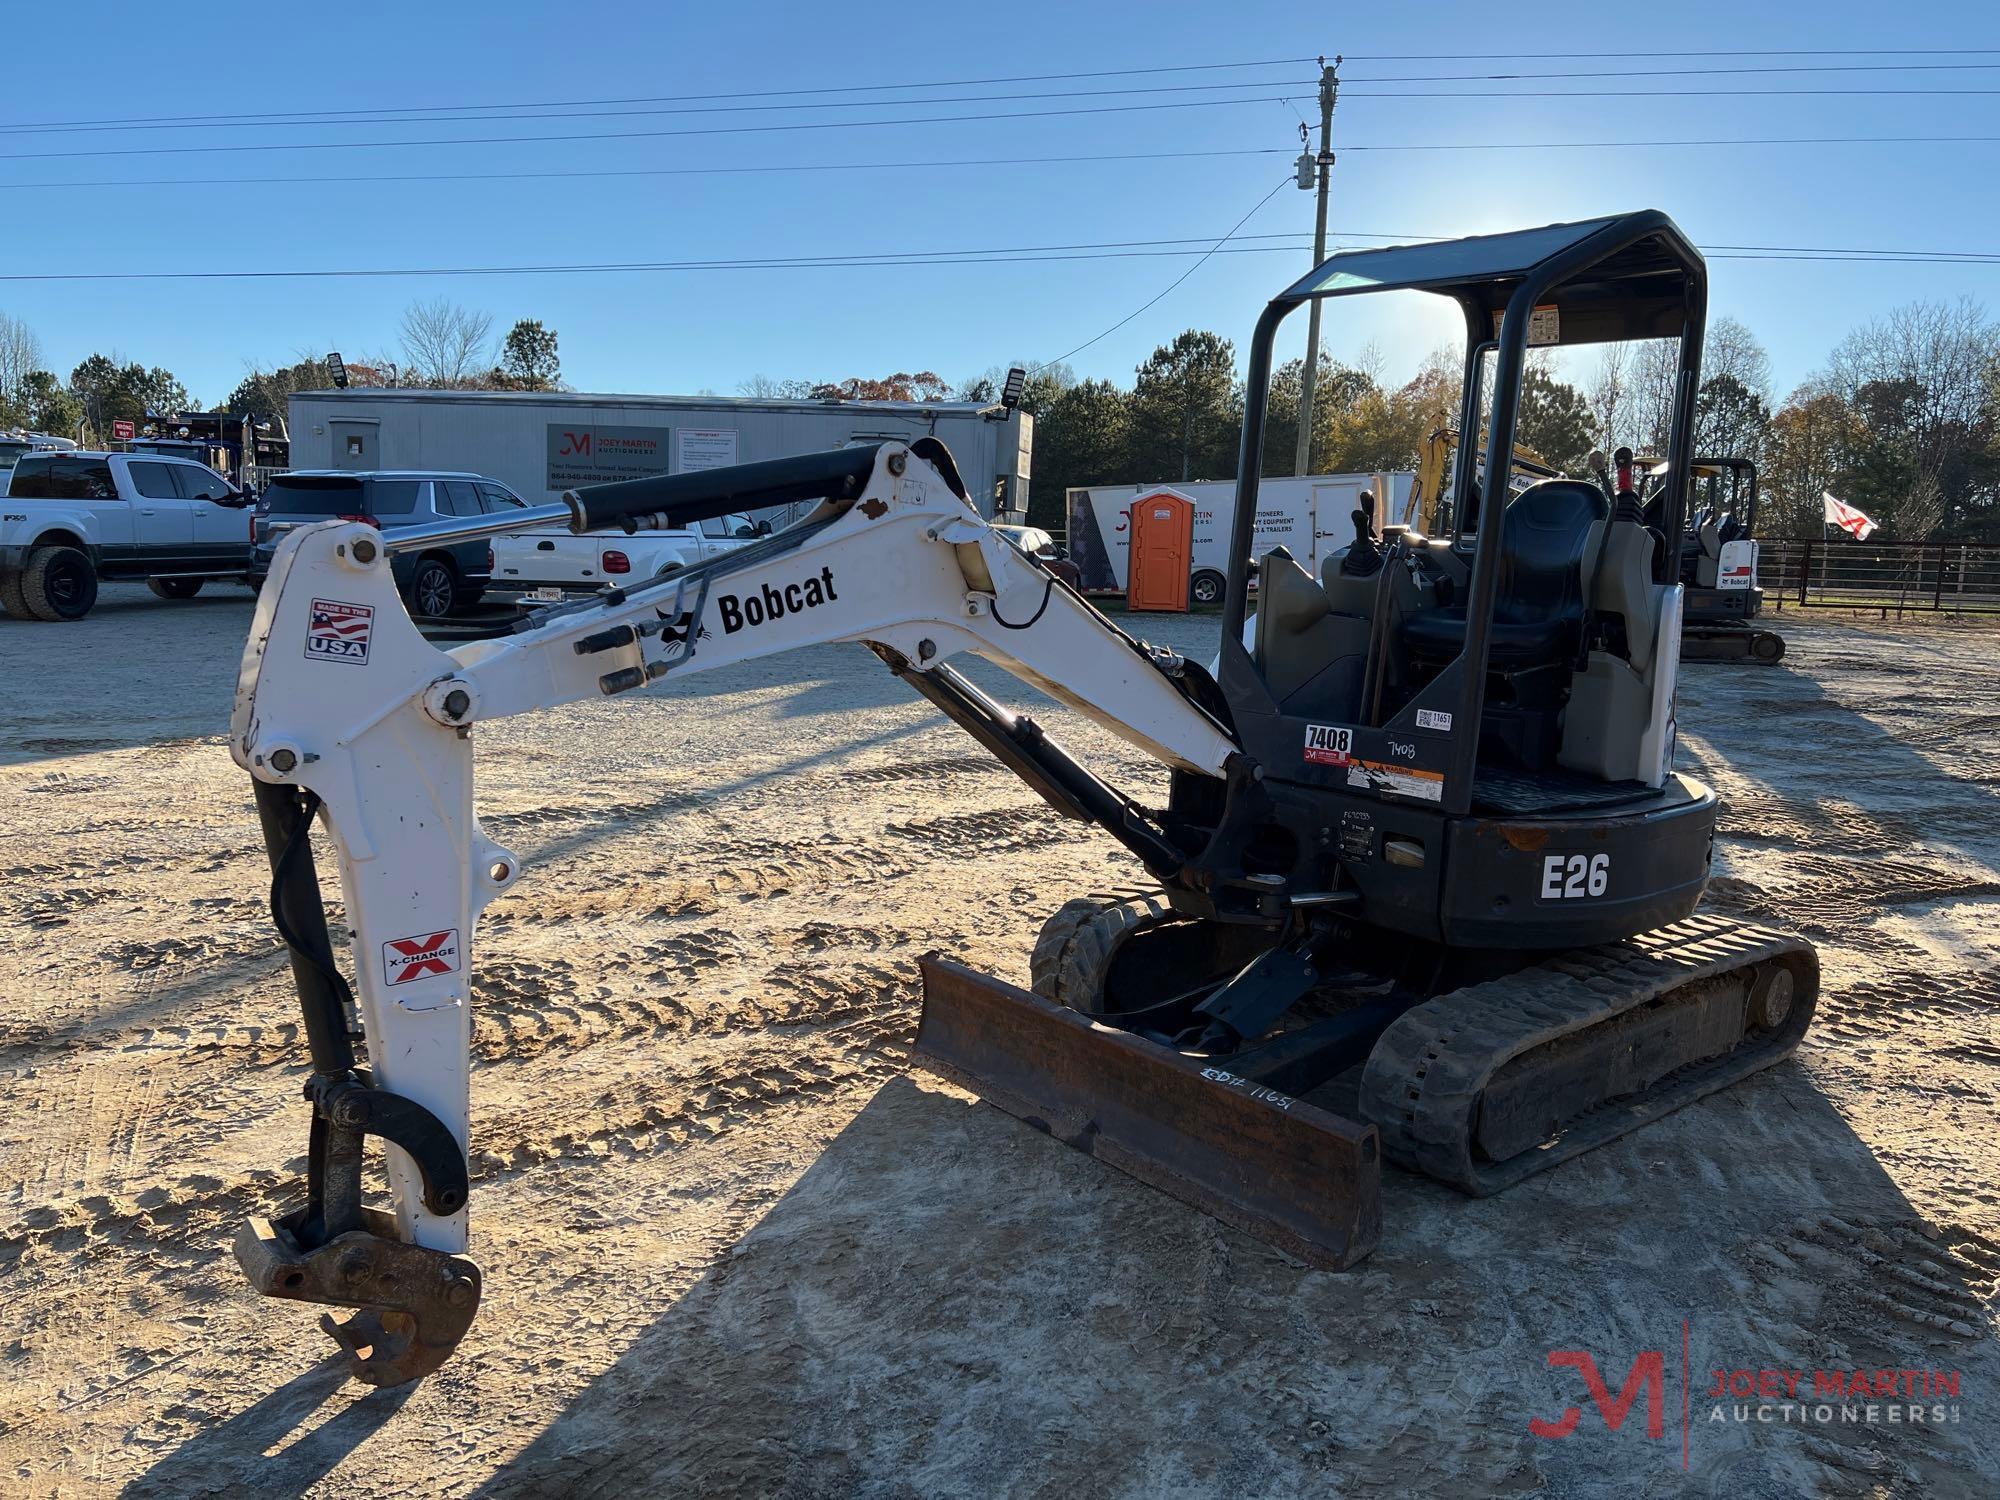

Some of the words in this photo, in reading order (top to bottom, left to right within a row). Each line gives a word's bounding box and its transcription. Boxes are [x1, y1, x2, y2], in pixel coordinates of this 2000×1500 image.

[115, 423, 133, 431] WRONG
[559, 432, 591, 456] JM
[598, 439, 621, 447] JOEY
[622, 440, 657, 448] MARTIN
[317, 603, 340, 612] MADE
[352, 608, 368, 617] THE
[717, 566, 838, 635] Bobcat
[309, 637, 364, 656] USA
[1433, 712, 1451, 724] 11651
[1308, 726, 1349, 752] 7408
[1387, 741, 1416, 760] 7408
[1385, 766, 1414, 776] WARNING
[1541, 853, 1610, 899] E26
[389, 948, 456, 967] X-CHANGE
